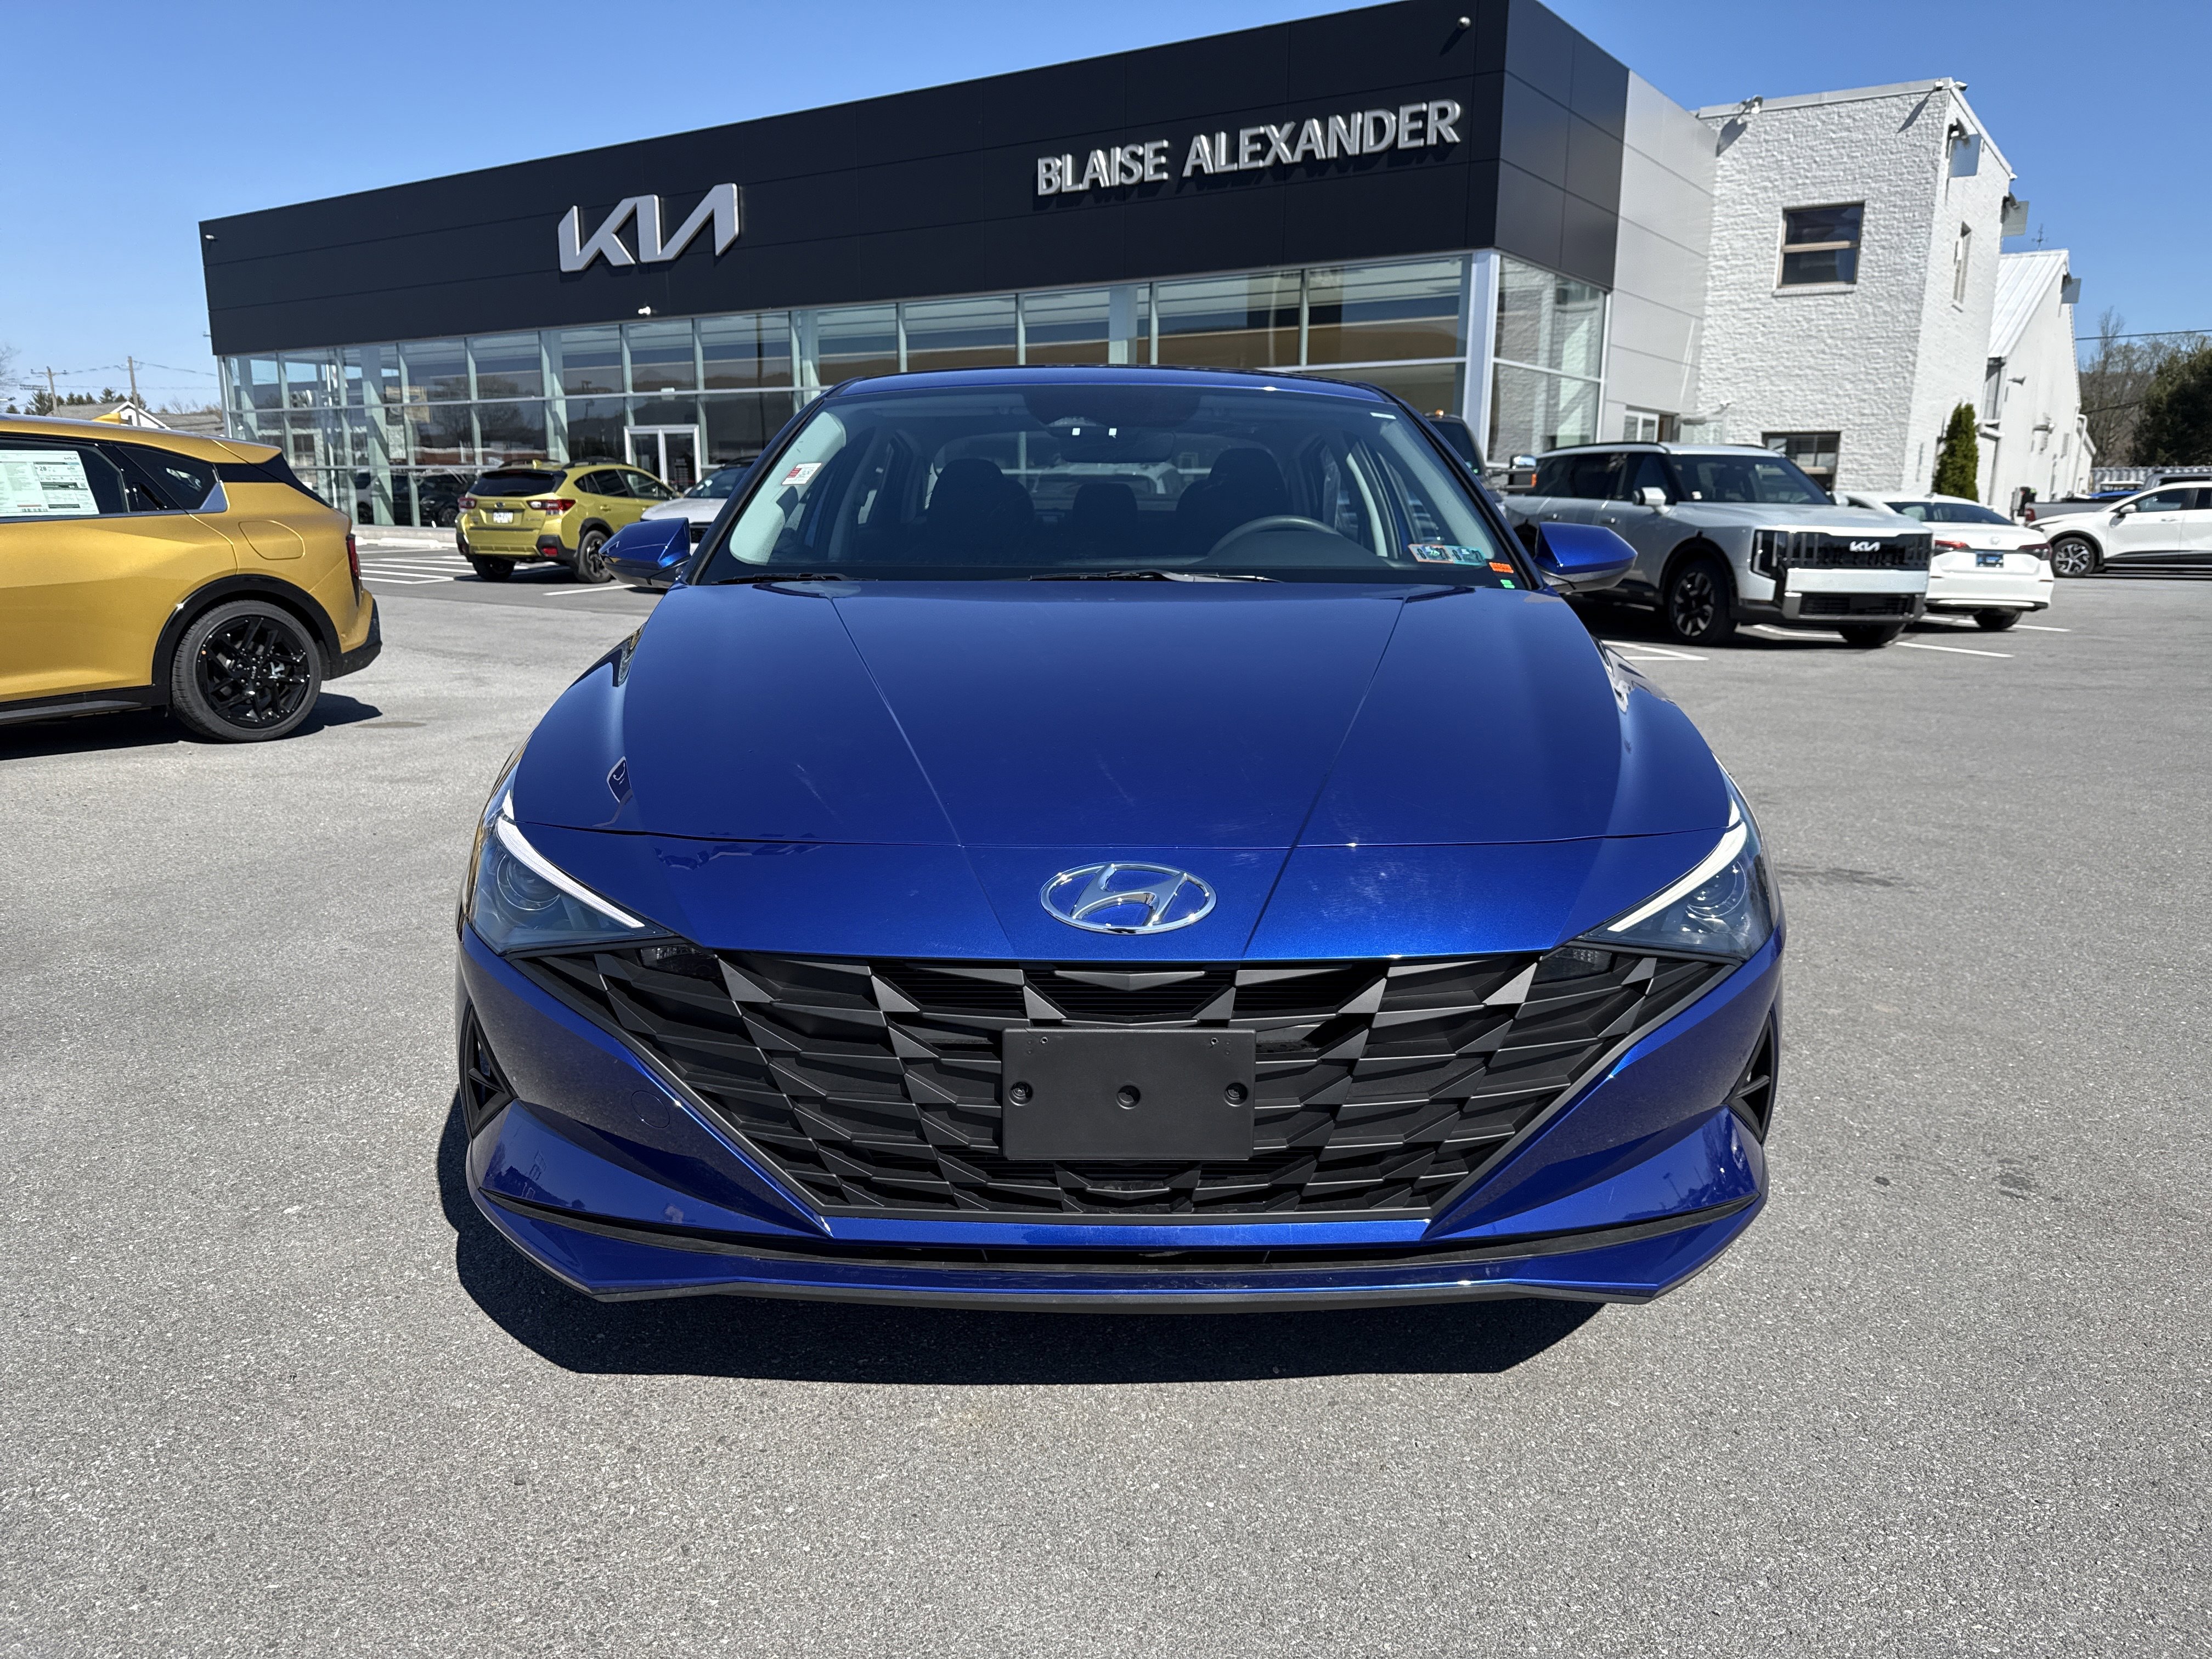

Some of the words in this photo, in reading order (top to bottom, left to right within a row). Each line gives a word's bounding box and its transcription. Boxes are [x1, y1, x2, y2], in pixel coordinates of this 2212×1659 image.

[1037, 139, 1169, 196] BLAISE
[1182, 98, 1462, 178] ALEXANDER
[557, 182, 740, 273] KIA
[1849, 540, 1881, 552] KIA
